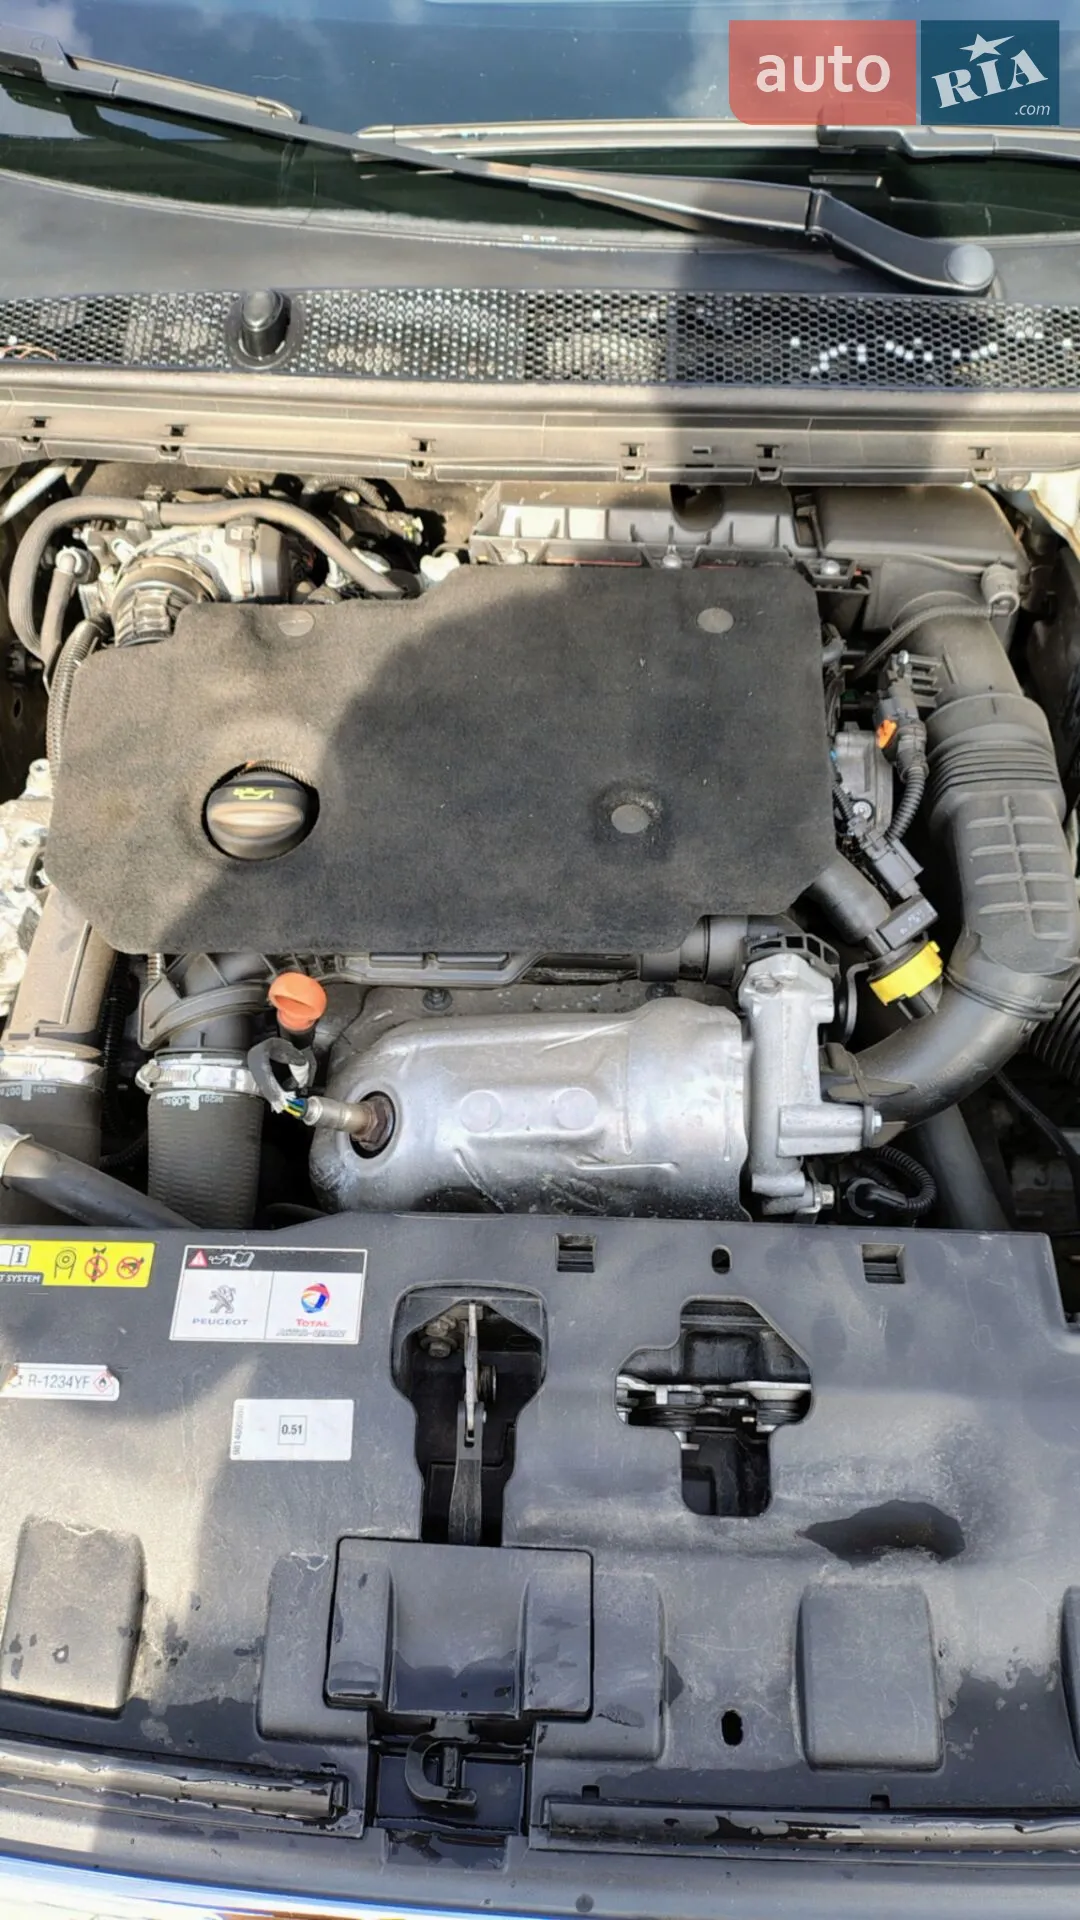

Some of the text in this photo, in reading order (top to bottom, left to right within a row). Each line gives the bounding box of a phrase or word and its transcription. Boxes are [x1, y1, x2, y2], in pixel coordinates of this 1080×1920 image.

[6, 1274, 41, 1283] SYSTEM
[192, 1318, 249, 1326] PEUGEOT
[28, 1373, 91, 1389] R-1234YF
[281, 1424, 303, 1435] 0.51
